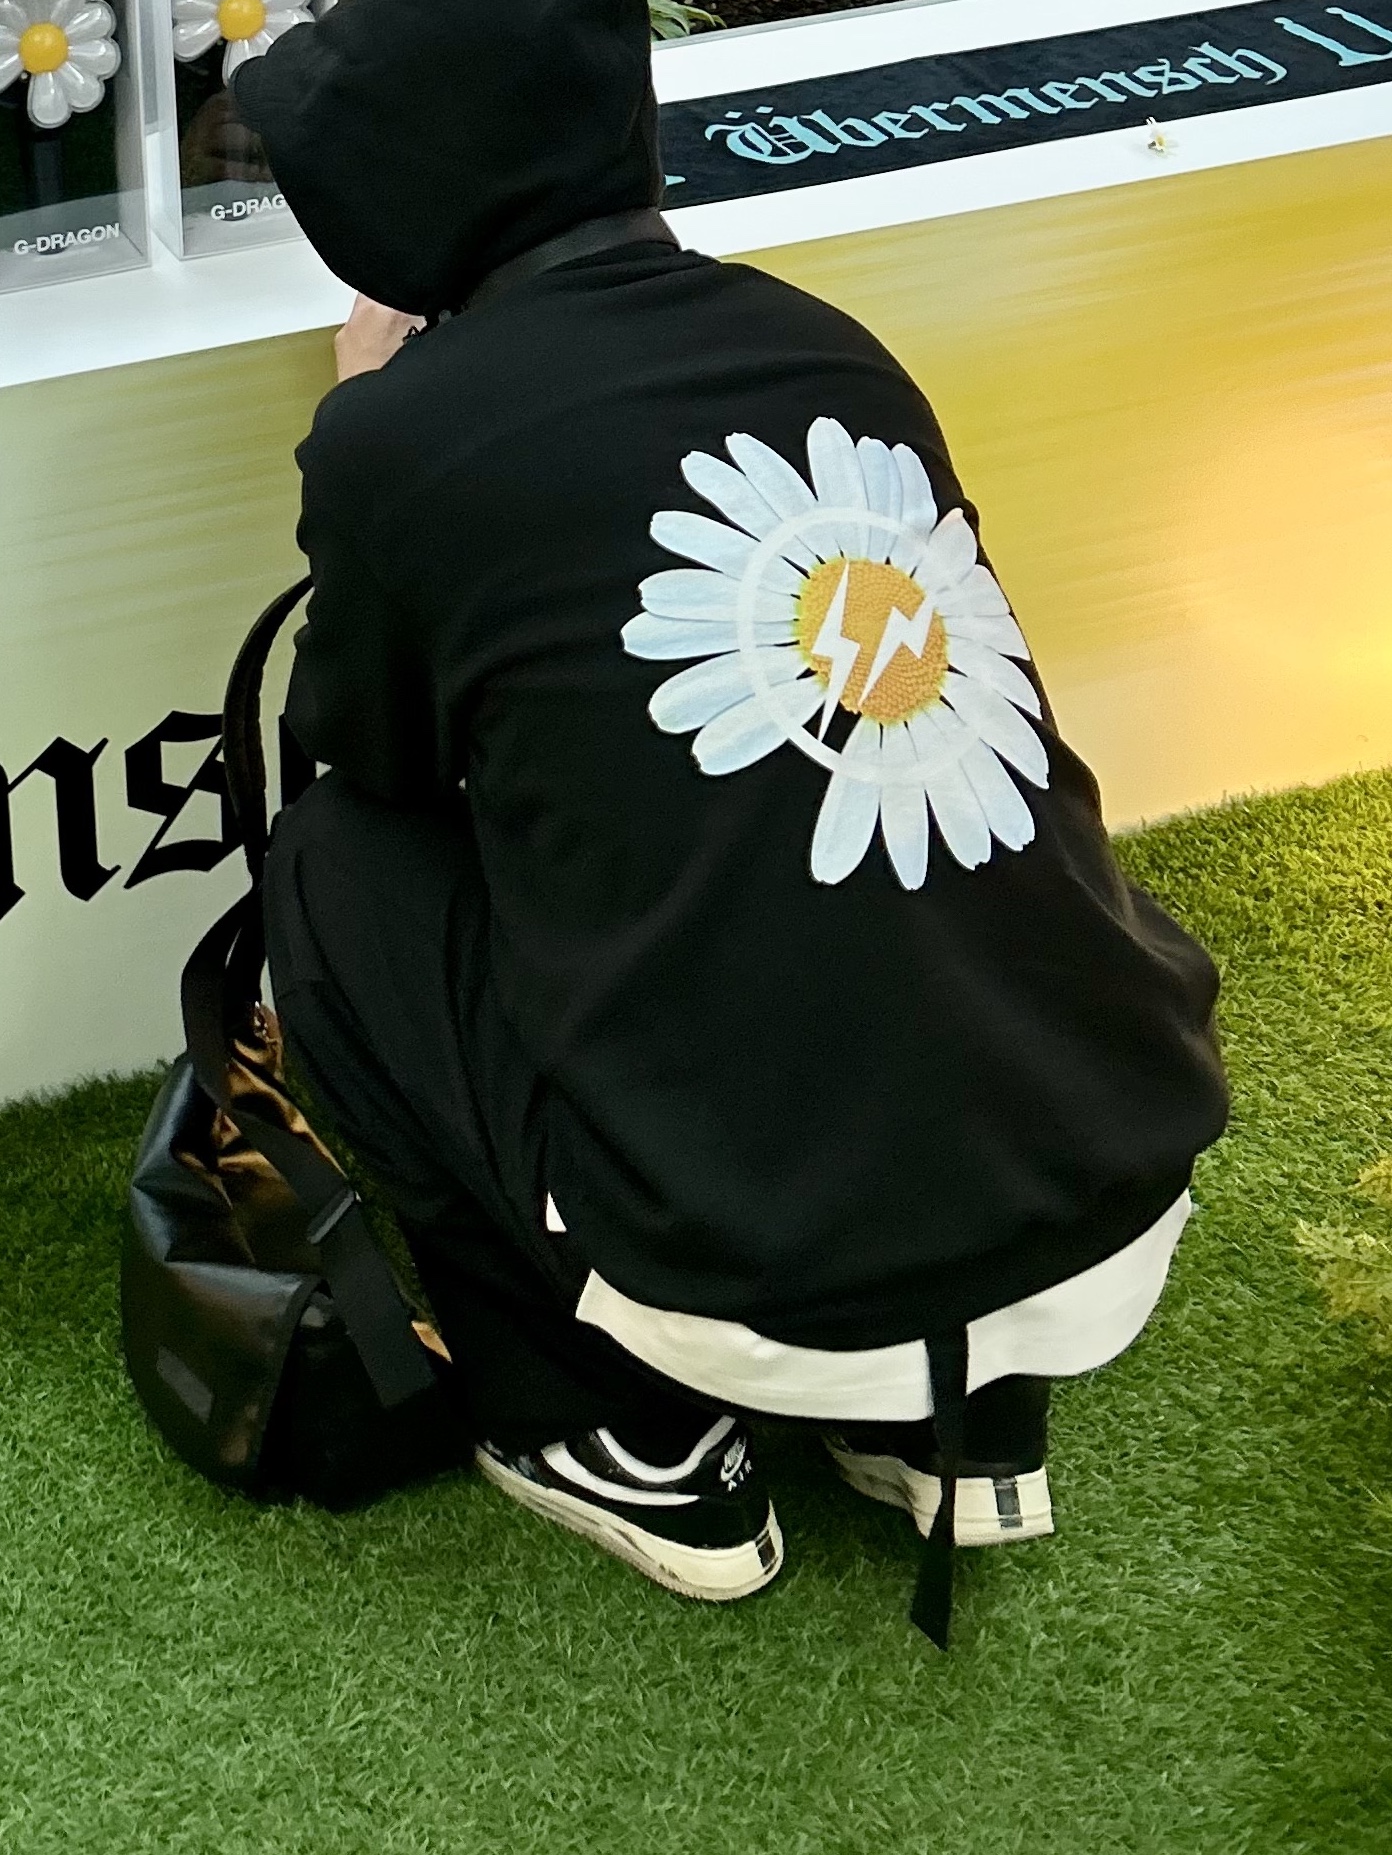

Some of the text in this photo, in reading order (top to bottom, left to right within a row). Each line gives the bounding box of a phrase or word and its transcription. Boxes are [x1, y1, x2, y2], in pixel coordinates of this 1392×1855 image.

[705, 41, 1288, 165] Übermensch
[210, 193, 285, 221] G-DRAG
[13, 222, 120, 256] G-DRAGON
